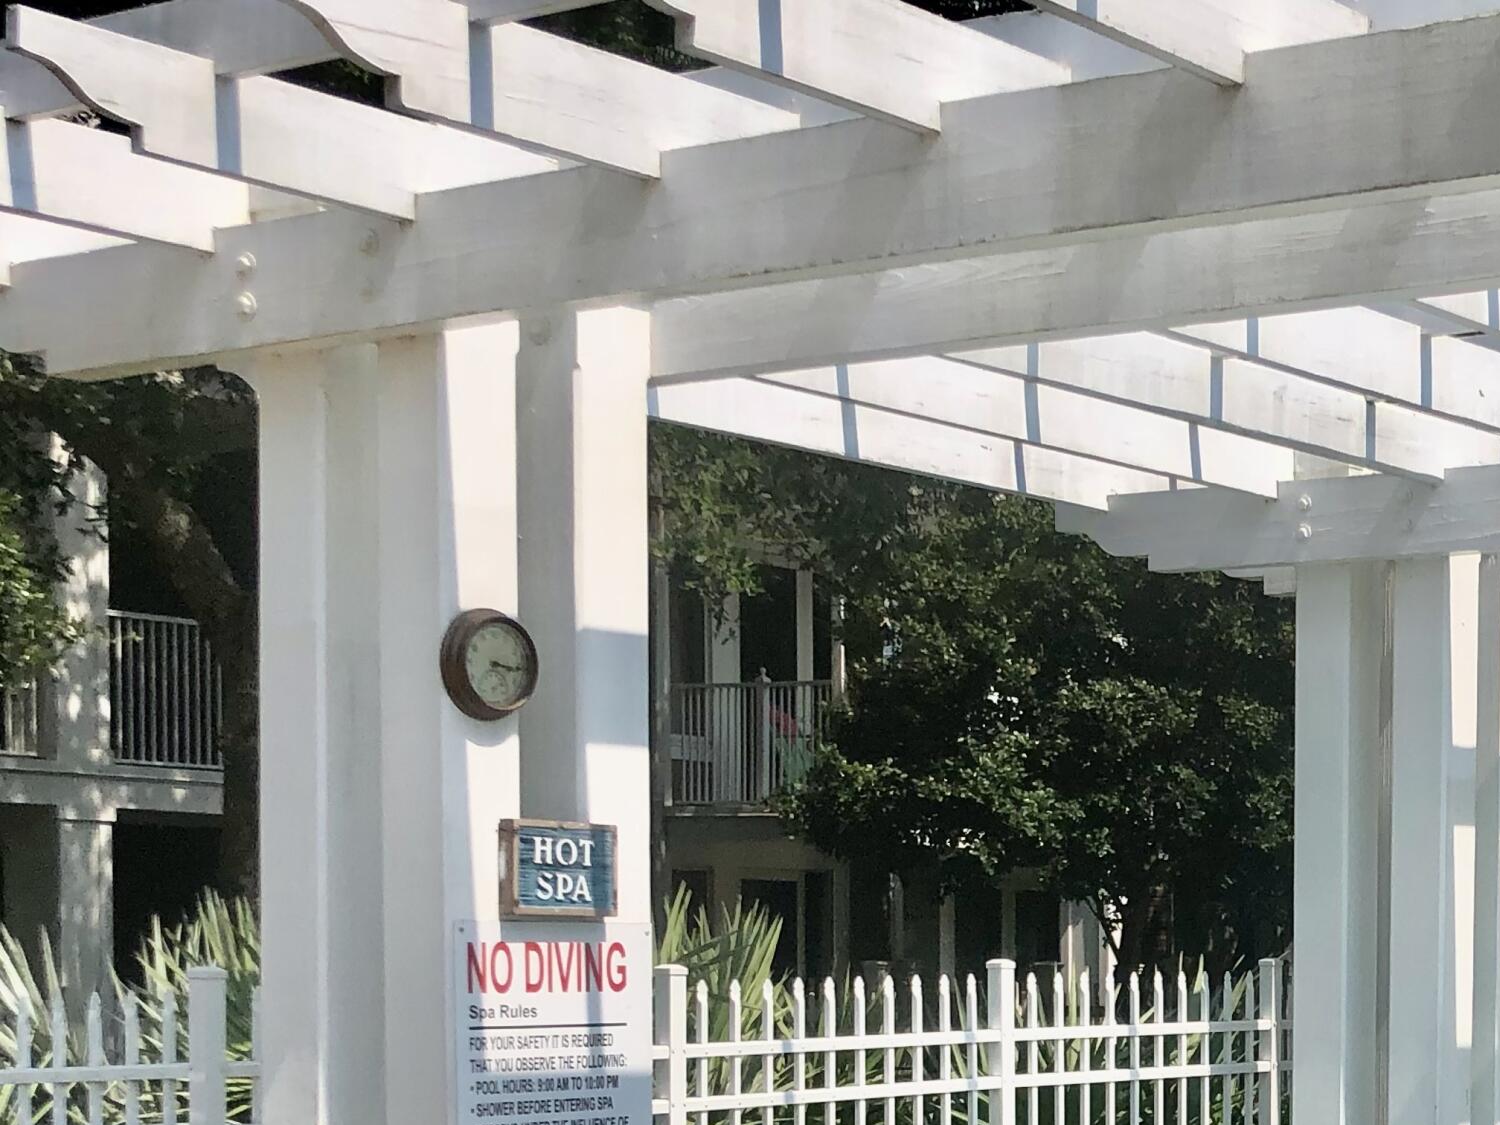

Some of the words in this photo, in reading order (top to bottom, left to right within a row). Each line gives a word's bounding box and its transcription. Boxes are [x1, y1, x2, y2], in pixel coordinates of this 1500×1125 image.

[533, 837, 595, 866] HOT
[536, 872, 592, 902] SPA
[467, 941, 513, 993] NO
[525, 941, 627, 992] DIVING
[469, 1005, 495, 1022] Spa
[500, 1004, 537, 1018] Rules
[470, 1037, 488, 1051] FOR
[490, 1036, 514, 1050] YOUR
[517, 1035, 549, 1049] SAFETY
[552, 1035, 558, 1047] IT
[562, 1035, 569, 1047] IS
[572, 1033, 613, 1048] REQUIRED
[470, 1058, 492, 1073] THAT
[495, 1058, 513, 1072] YOU
[516, 1057, 555, 1071] OBSERVE
[559, 1056, 574, 1069] THE
[476, 1081, 500, 1094] POOL
[557, 1077, 570, 1091] AM
[572, 1077, 582, 1090] TO
[585, 1076, 604, 1090] 10:00
[607, 1075, 619, 1088] PM
[477, 1101, 515, 1117] SHOWER
[518, 1100, 551, 1114] BEFORE
[554, 1098, 595, 1112] ENTERING
[598, 1096, 613, 1110] SPA
